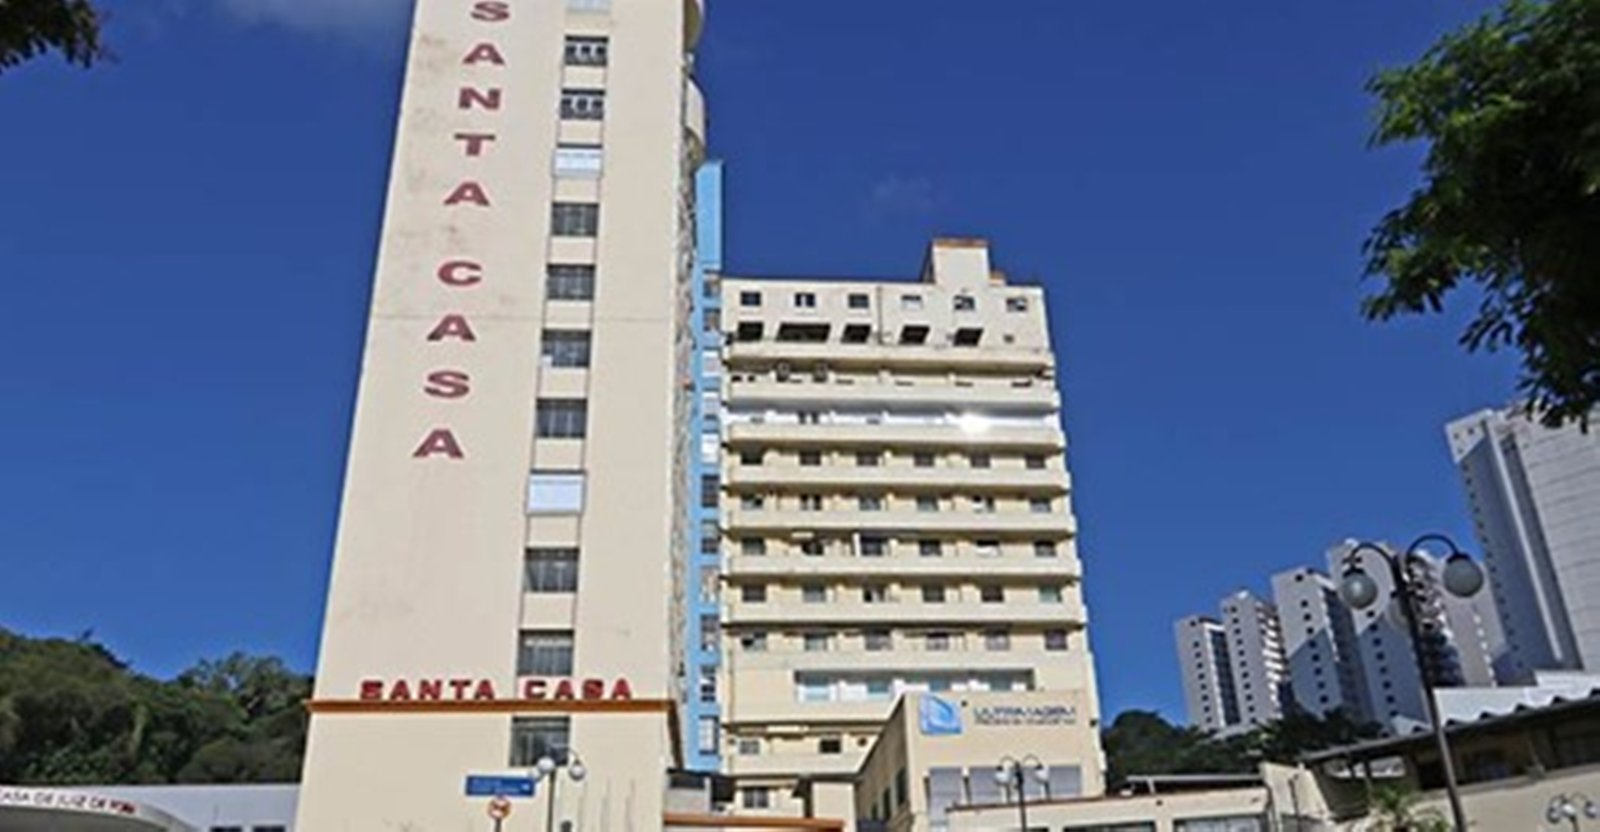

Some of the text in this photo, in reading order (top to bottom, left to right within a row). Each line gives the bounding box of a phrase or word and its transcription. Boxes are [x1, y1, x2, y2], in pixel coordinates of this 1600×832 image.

[412, 0, 510, 459] SANTA CASA
[360, 678, 633, 701] SANTA CASA
[0, 790, 30, 803] ASA
